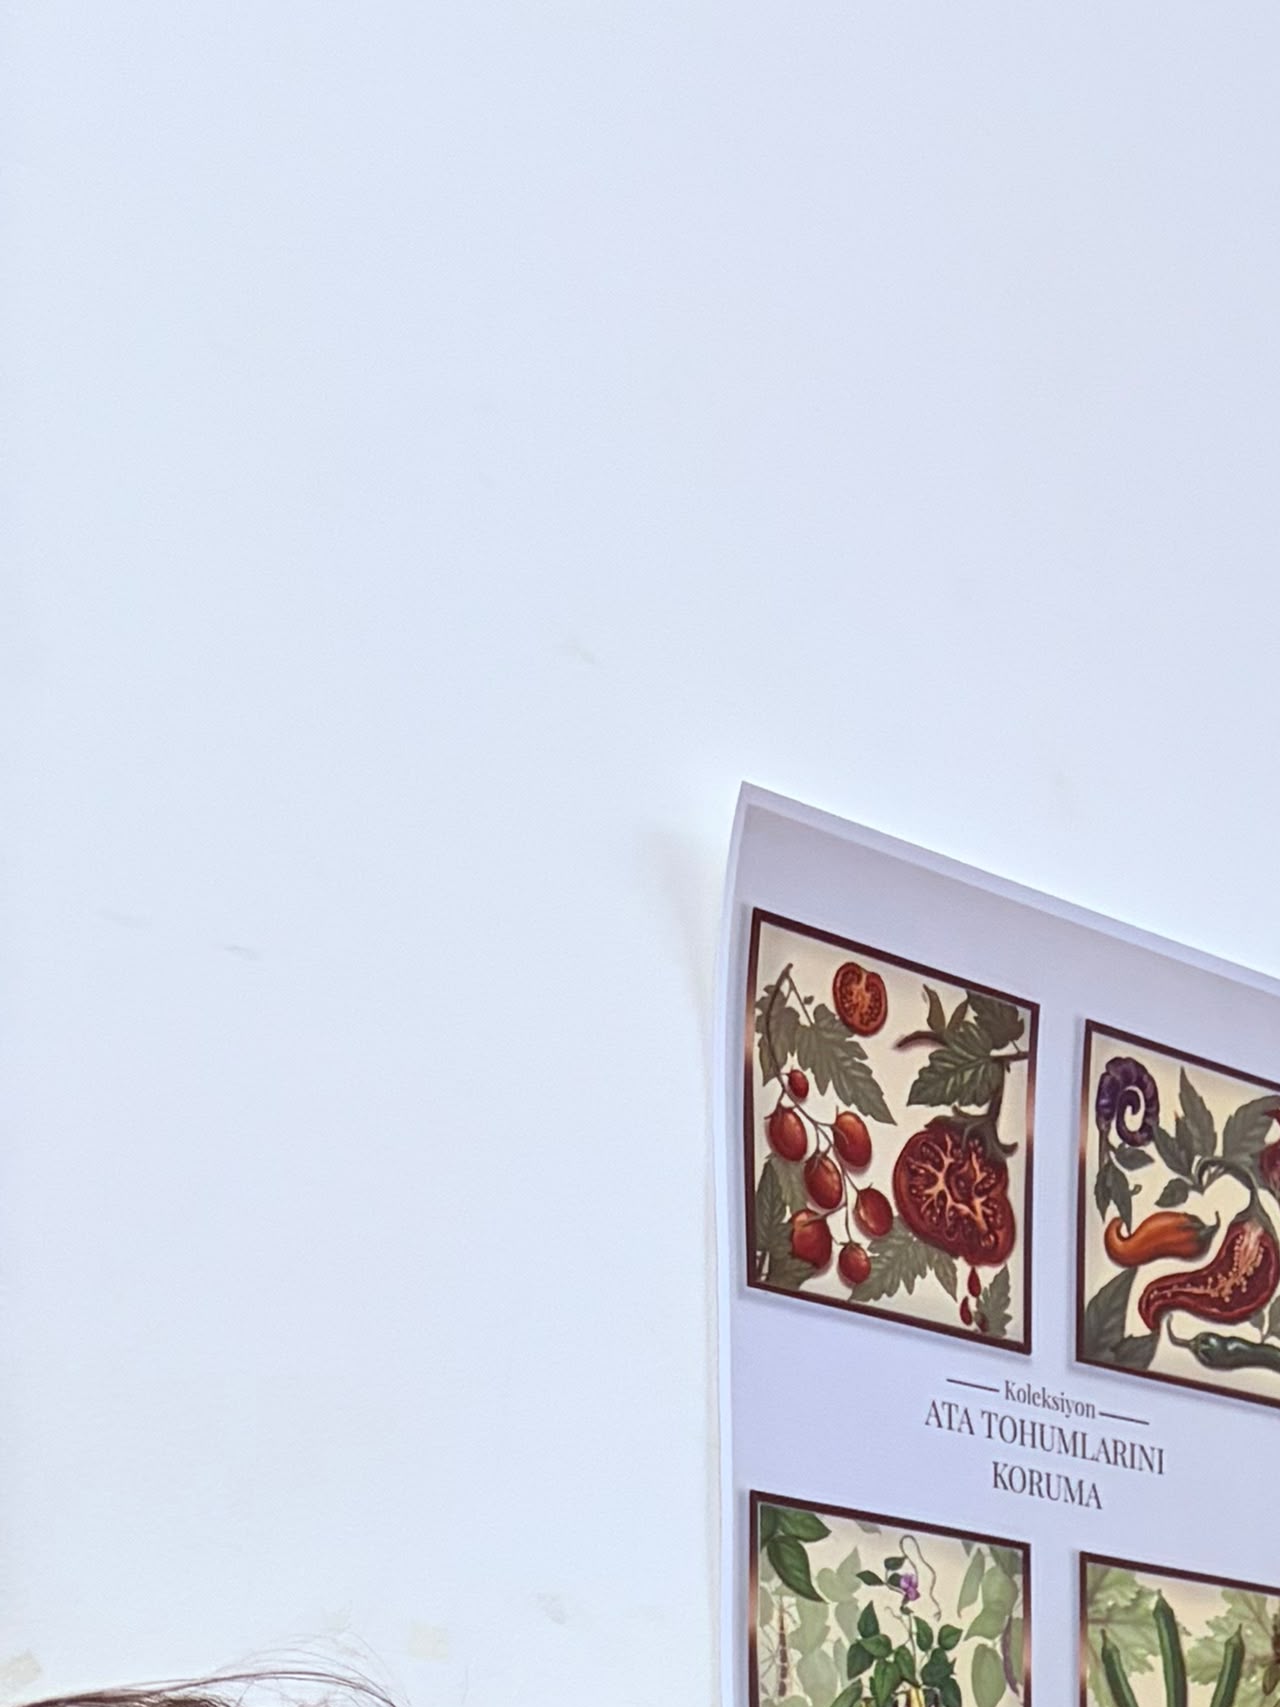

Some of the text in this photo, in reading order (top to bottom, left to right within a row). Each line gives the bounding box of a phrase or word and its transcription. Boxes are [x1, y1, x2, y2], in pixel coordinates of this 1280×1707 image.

[1005, 1380, 1096, 1419] Koleksiyon
[925, 1400, 1166, 1475] ATA TOHUMLARINI
[992, 1461, 1103, 1511] KORUMA
